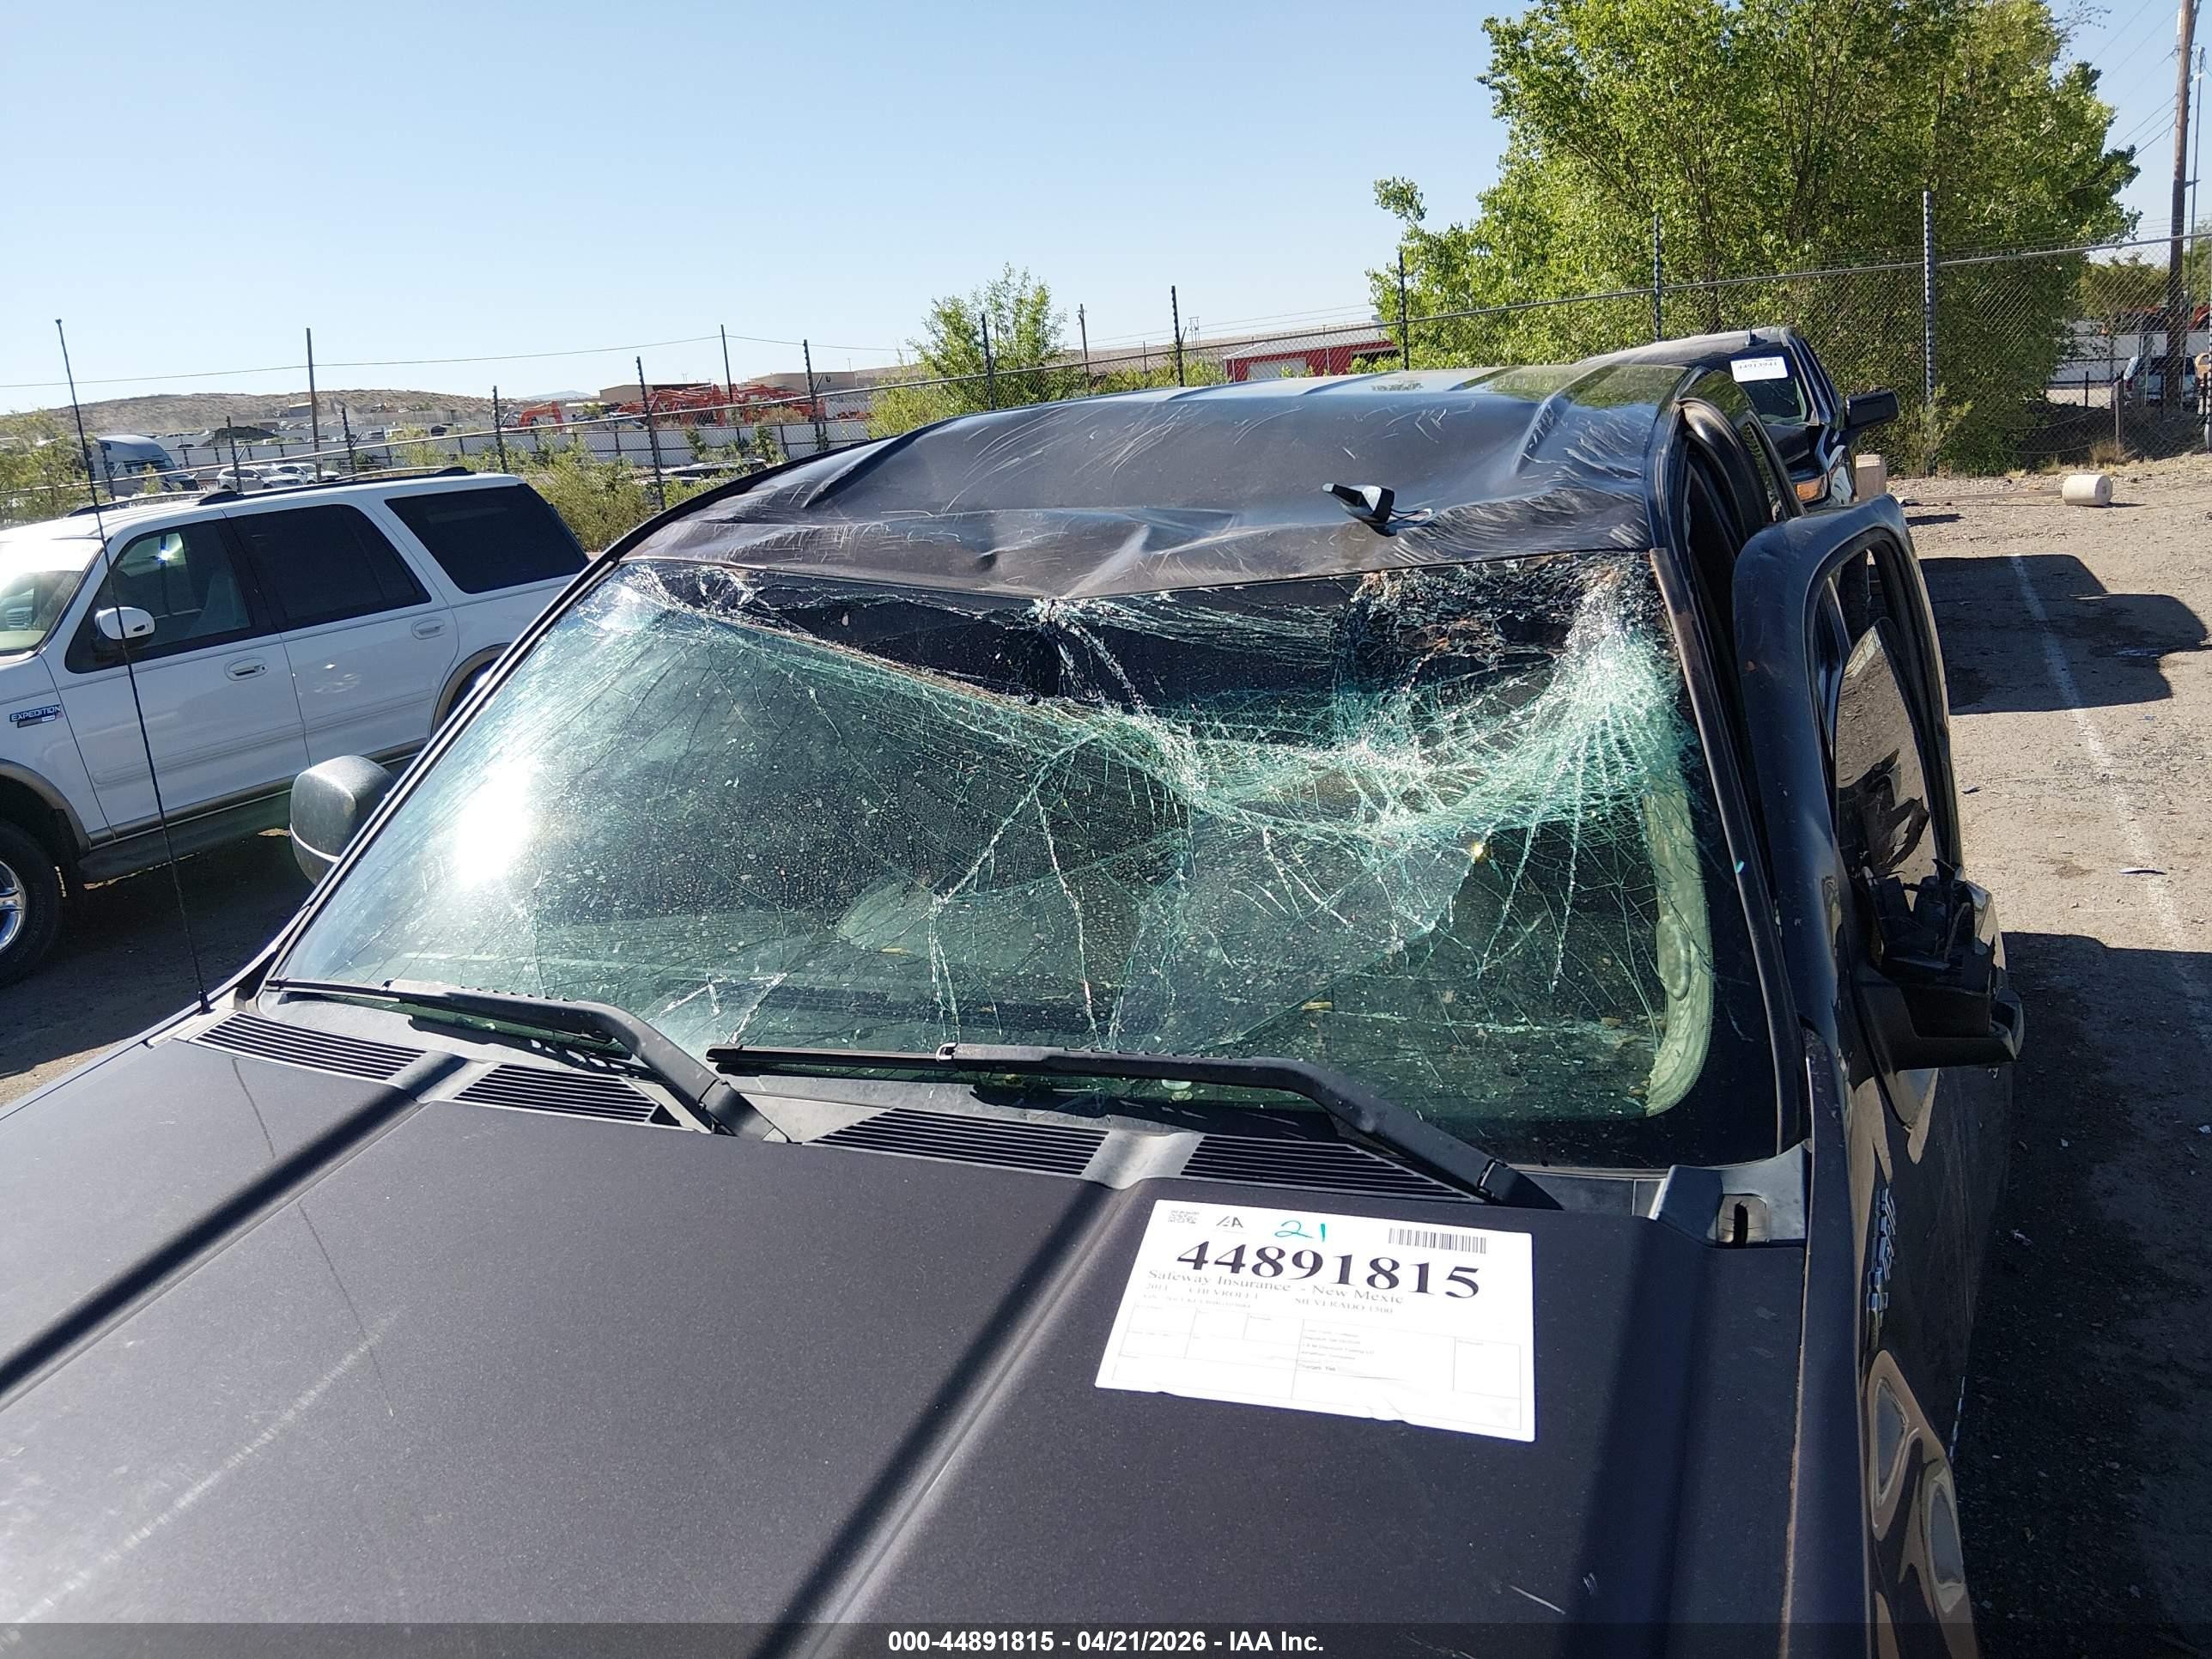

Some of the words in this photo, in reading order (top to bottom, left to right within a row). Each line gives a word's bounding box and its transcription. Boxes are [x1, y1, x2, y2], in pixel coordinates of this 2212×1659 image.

[11, 705, 61, 721] EXPEDITION
[1274, 1219, 1327, 1243] 21
[1176, 1240, 1480, 1299] 44891815
[1147, 1269, 1212, 1285] Safeway
[1218, 1275, 1291, 1292] Insurance
[1311, 1285, 1351, 1297] New
